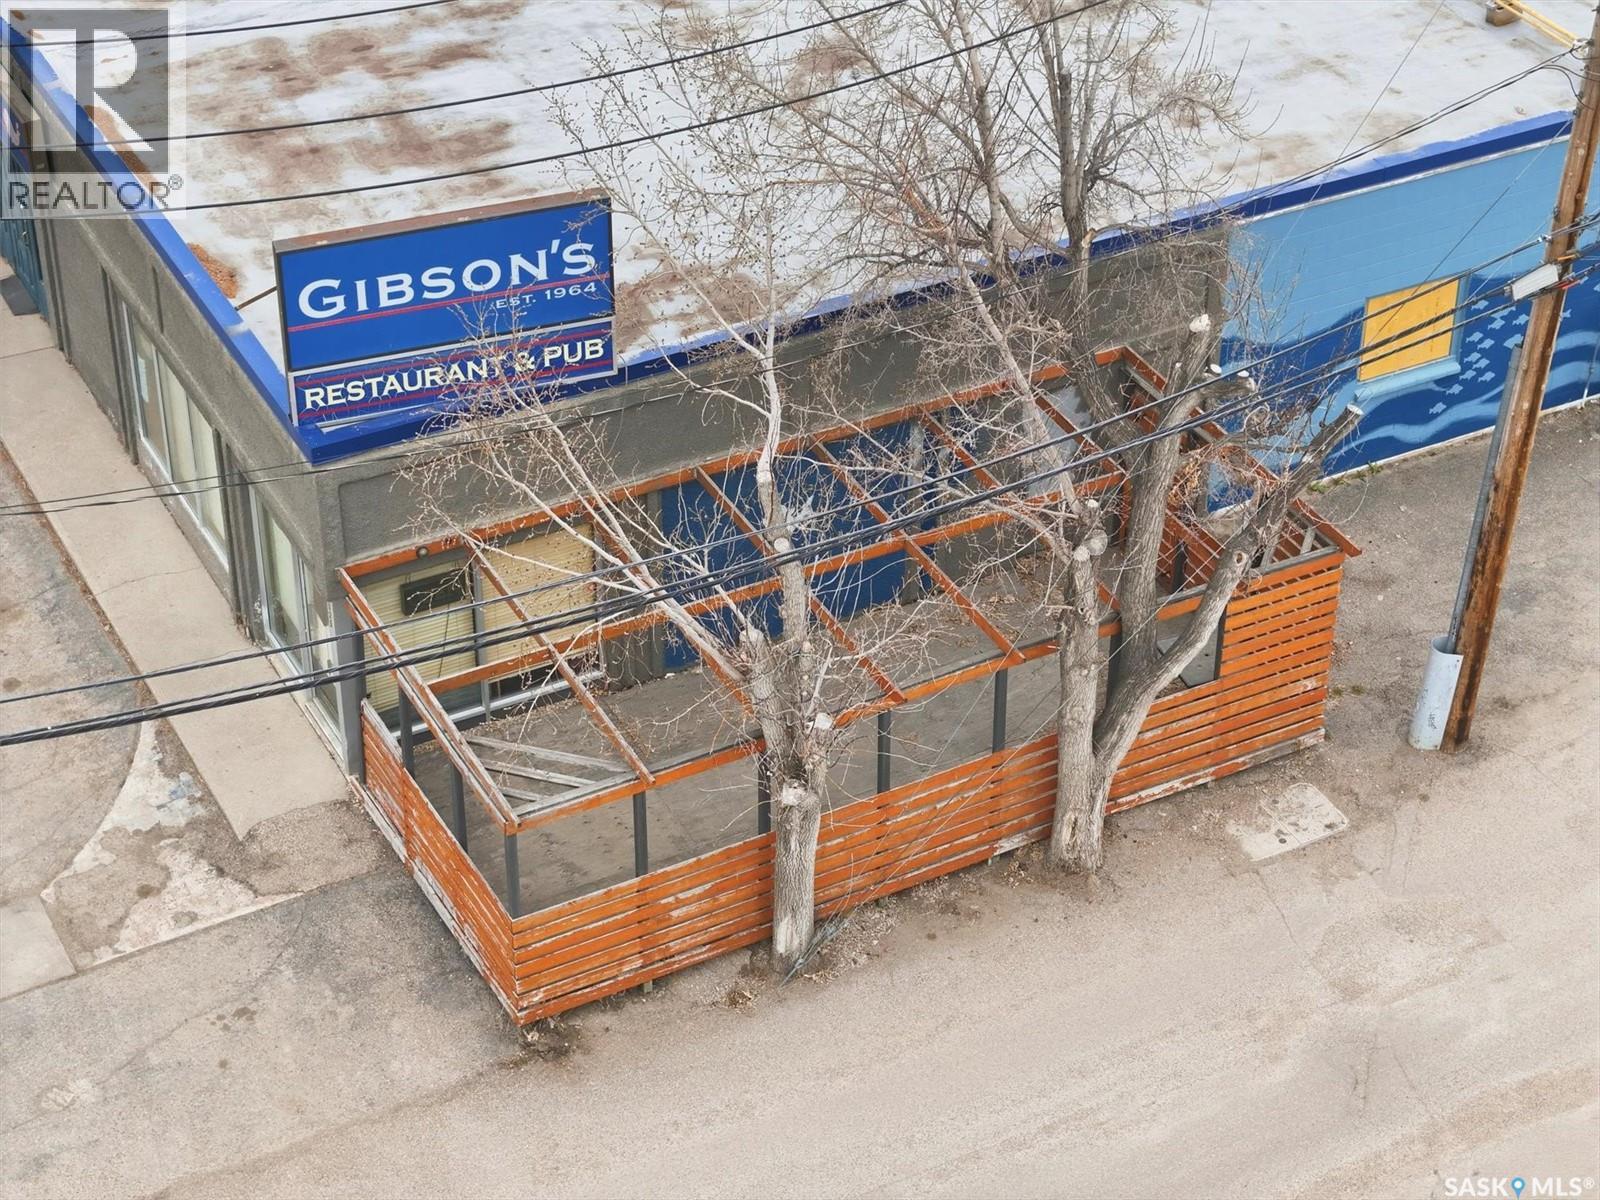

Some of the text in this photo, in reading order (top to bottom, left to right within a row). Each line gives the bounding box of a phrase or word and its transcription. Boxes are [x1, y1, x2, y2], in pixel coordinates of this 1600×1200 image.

[299, 239, 597, 319] GIBSON'S
[495, 282, 597, 309] EST. 1964
[514, 351, 536, 372] &
[543, 338, 605, 368] PUB
